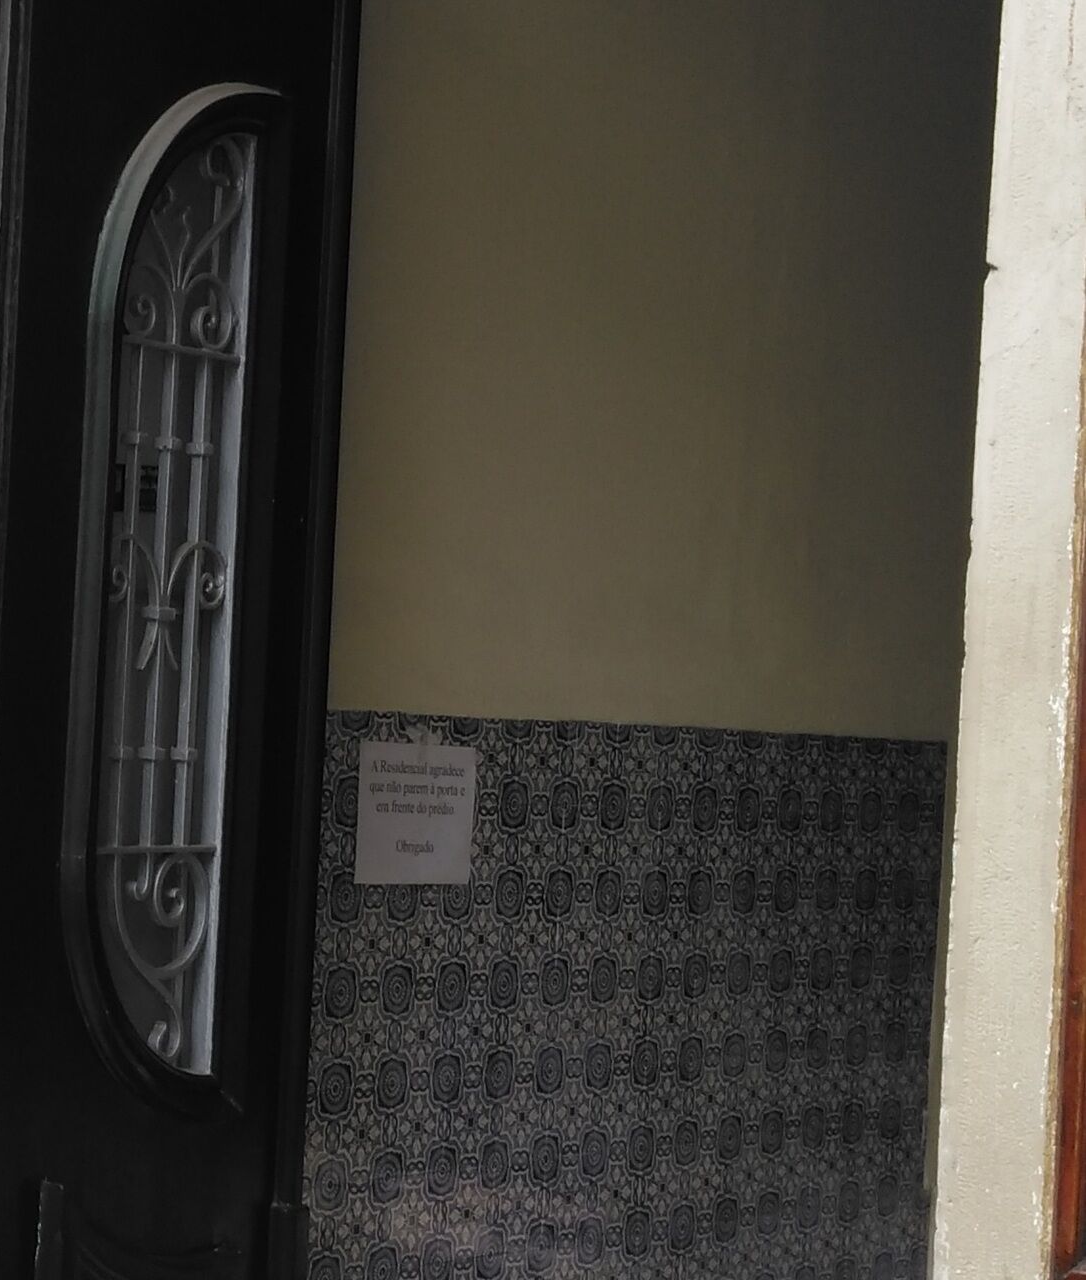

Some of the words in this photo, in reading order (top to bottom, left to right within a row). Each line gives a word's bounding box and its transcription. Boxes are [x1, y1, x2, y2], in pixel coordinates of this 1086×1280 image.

[380, 760, 428, 776] Residencial
[429, 763, 465, 779] agradece
[369, 782, 385, 795] que
[437, 785, 458, 798] porta
[391, 800, 415, 813] frente
[416, 802, 427, 814] do
[396, 840, 434, 856] Obrigado
